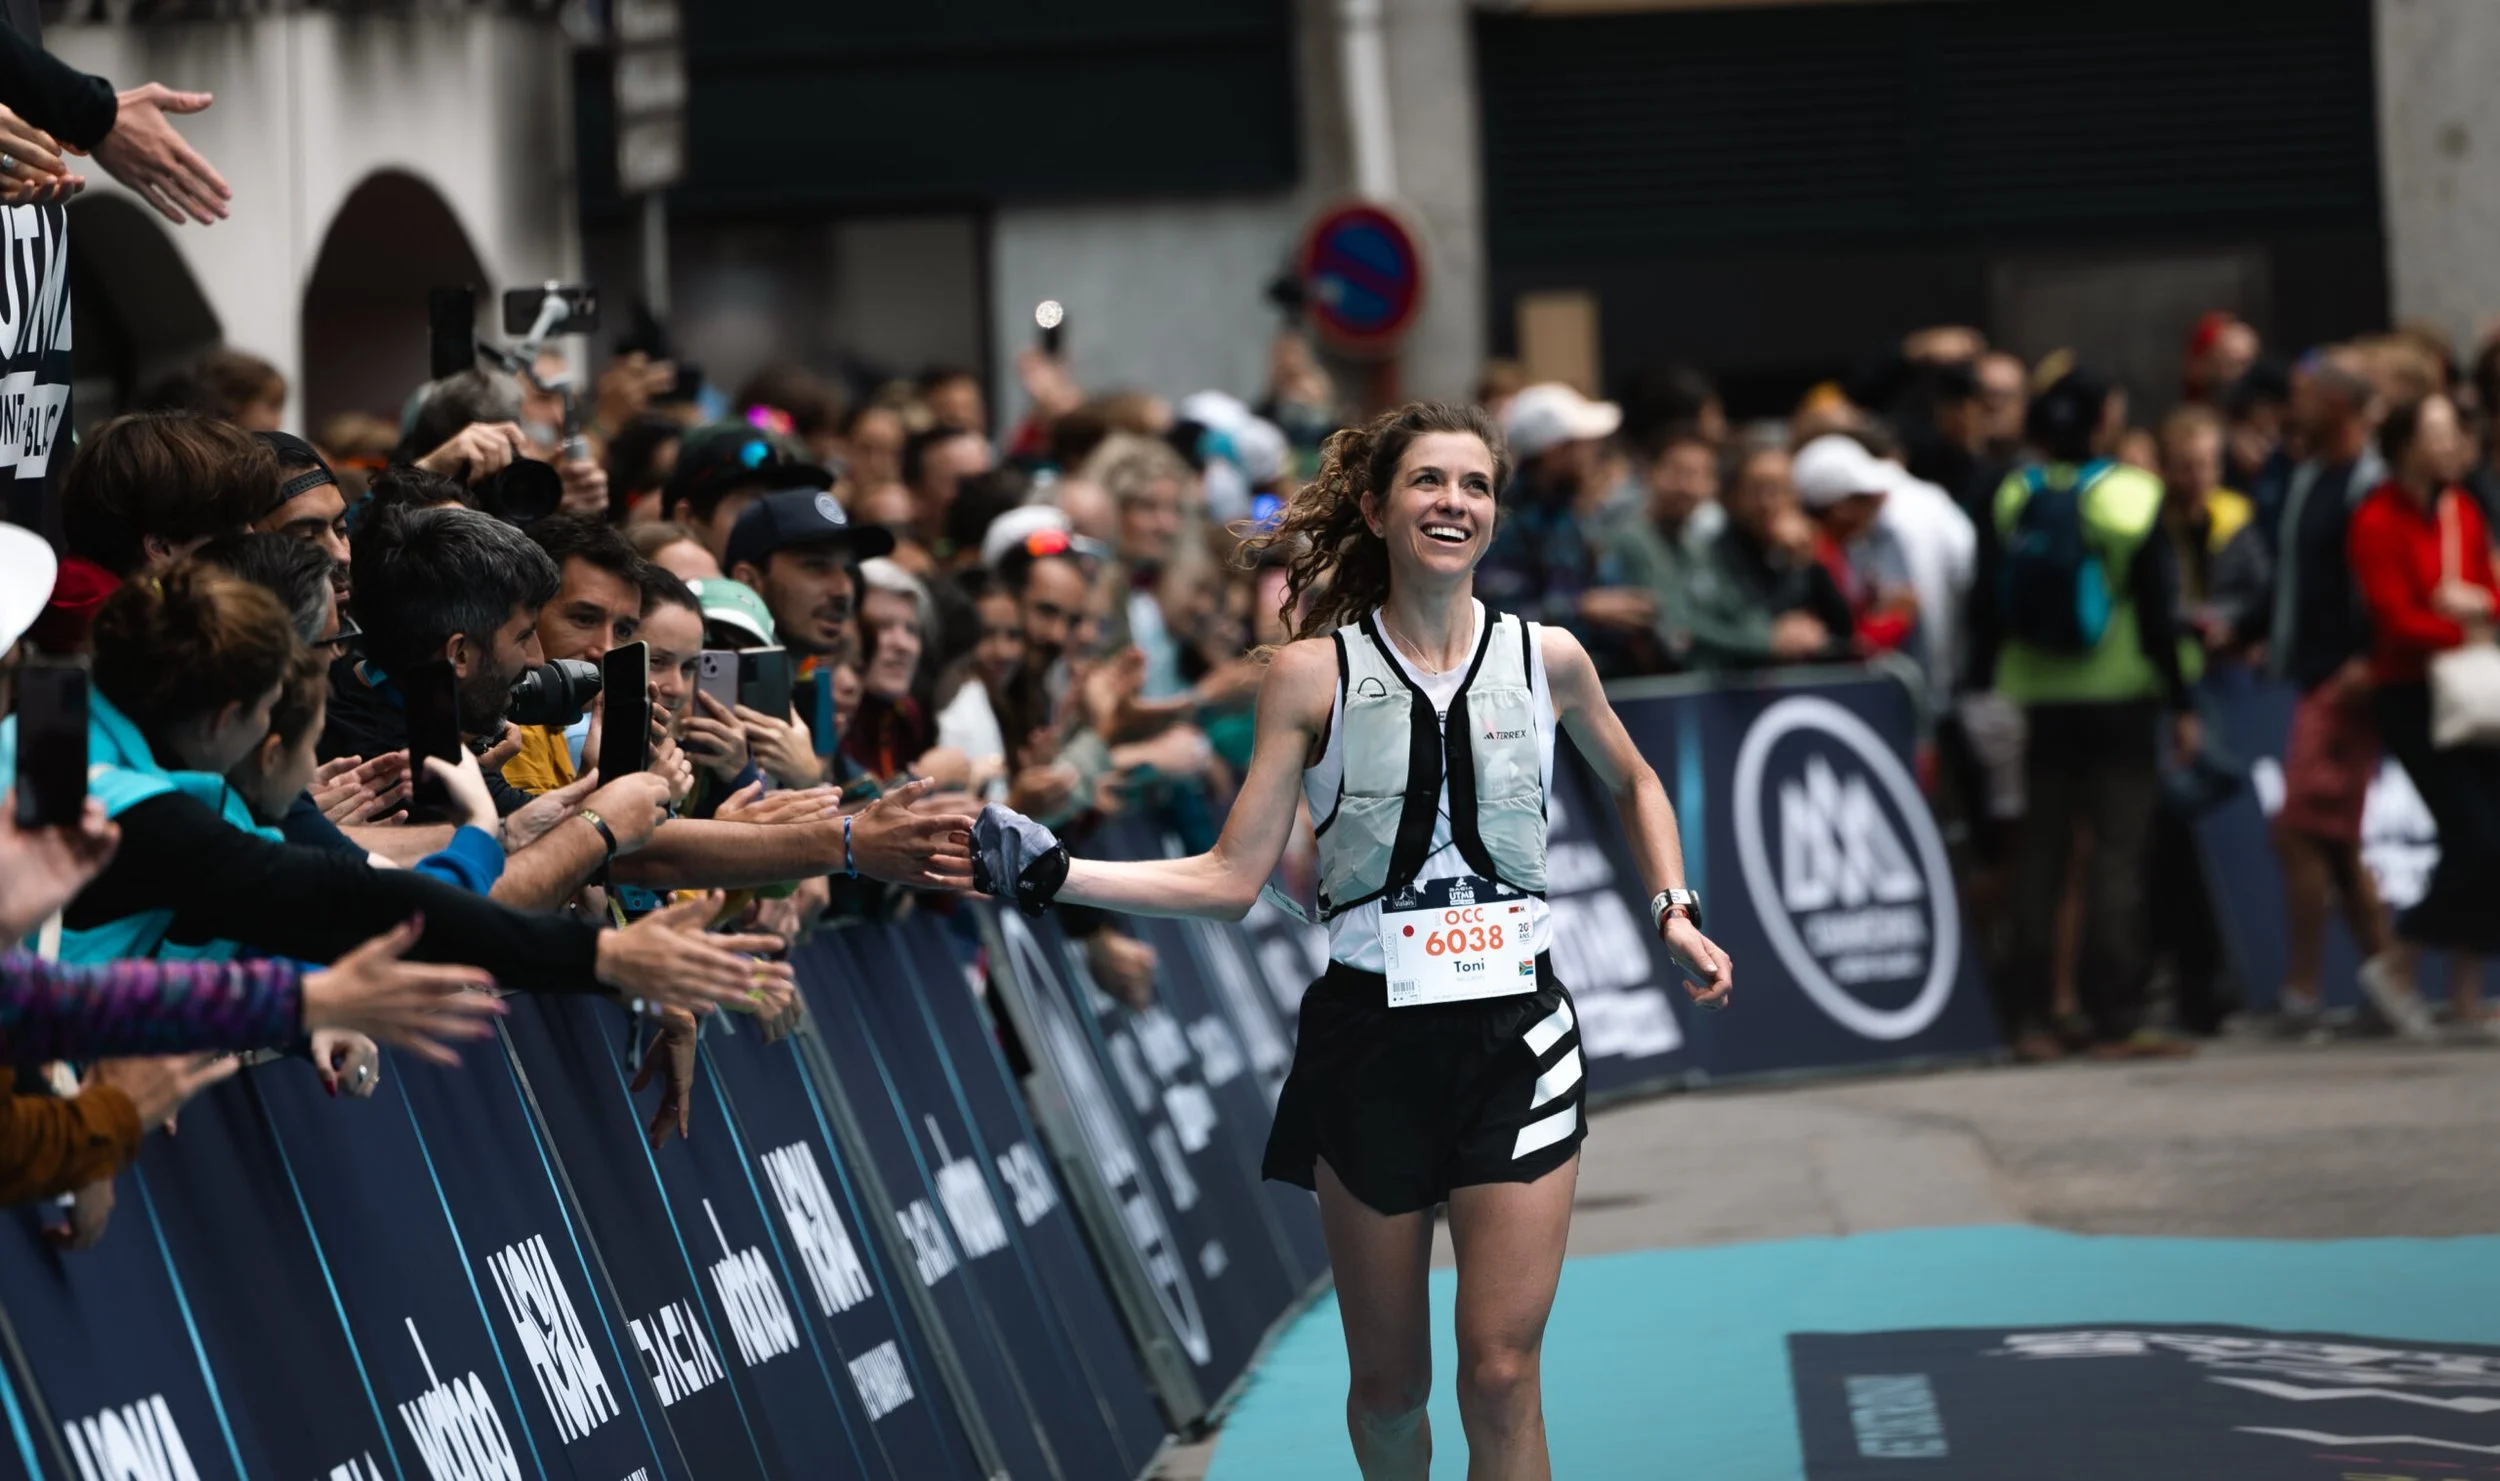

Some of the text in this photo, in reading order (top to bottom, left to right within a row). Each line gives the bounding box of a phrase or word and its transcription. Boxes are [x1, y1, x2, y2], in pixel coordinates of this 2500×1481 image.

[1445, 908, 1484, 925] OCC
[1449, 891, 1475, 900] UTMB
[1426, 924, 1504, 956] 6038
[1453, 957, 1486, 973] Toni
[760, 1139, 874, 1317] HOKA
[702, 1198, 800, 1367] wahoo
[486, 1233, 620, 1444] HOKA
[629, 1297, 724, 1407] DACIA
